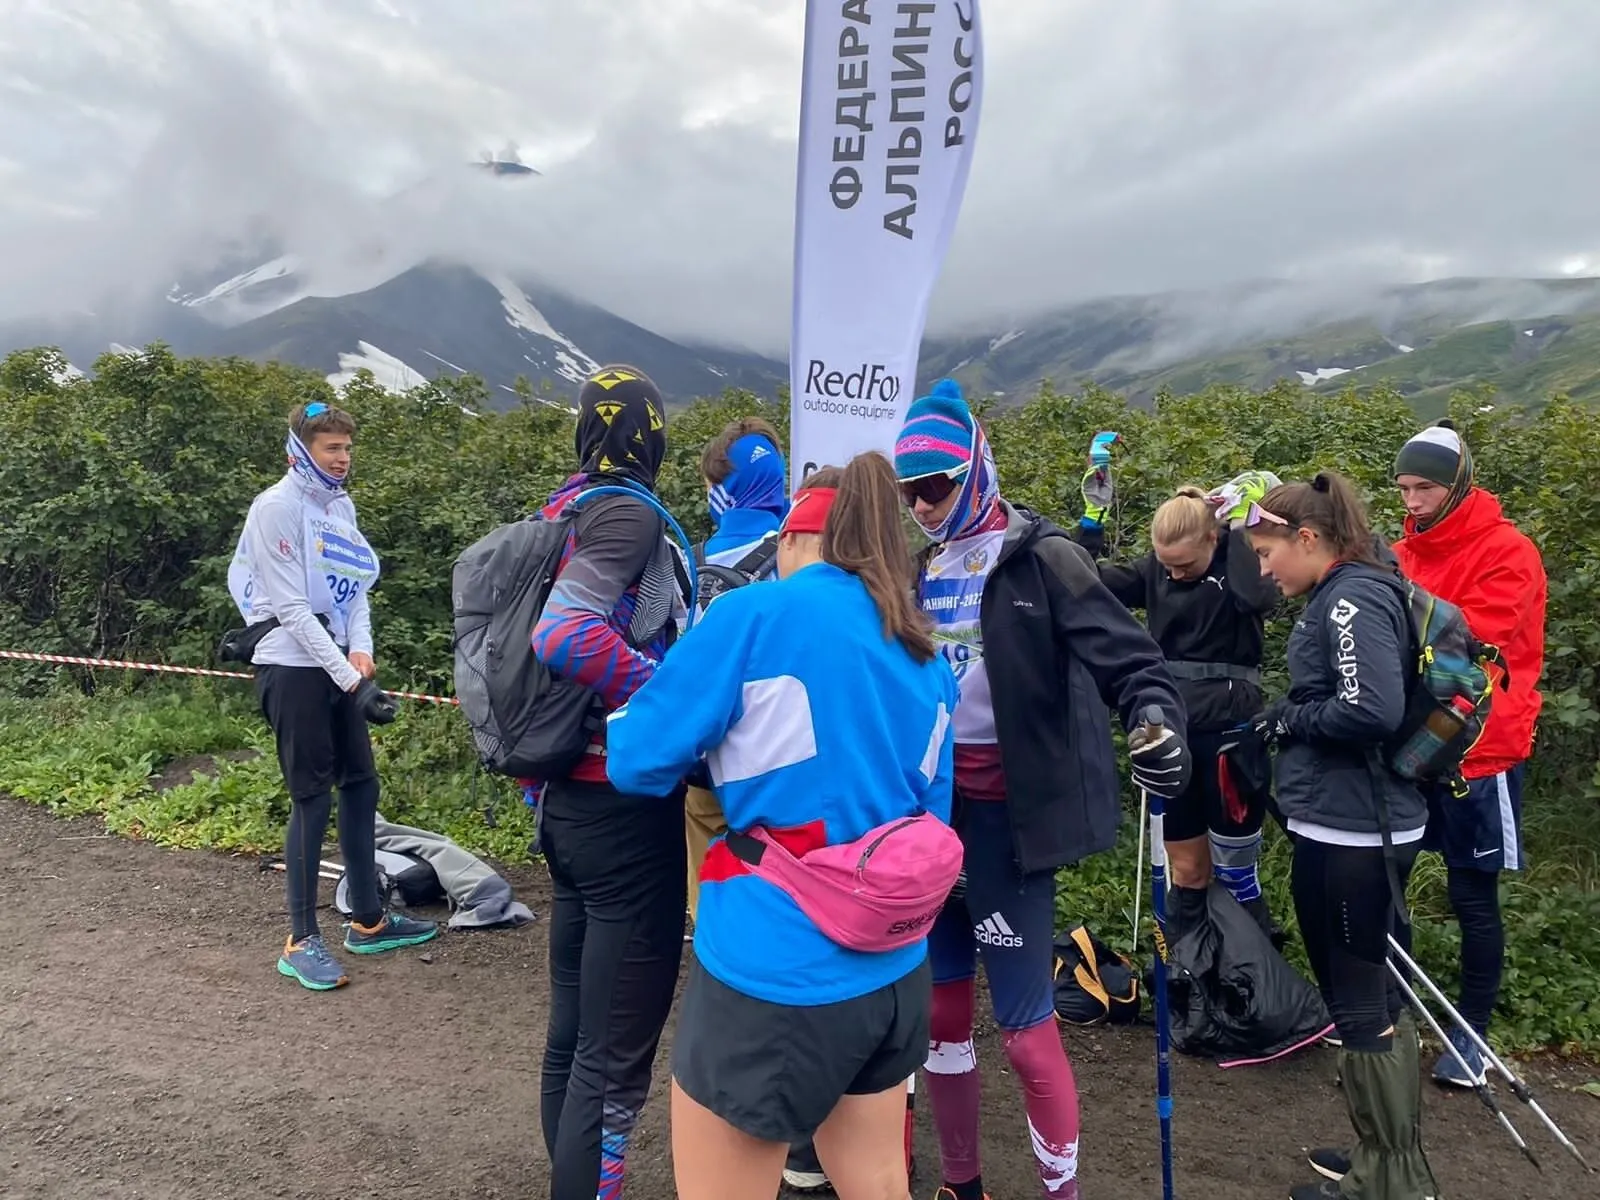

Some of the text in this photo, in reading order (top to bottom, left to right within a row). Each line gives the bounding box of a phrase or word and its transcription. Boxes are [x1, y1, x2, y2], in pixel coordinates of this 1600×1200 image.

[829, 0, 876, 209] ФЕДЕРА
[884, 3, 936, 240] АЛЬПИН
[803, 398, 848, 414] outdoor
[1337, 623, 1360, 705] RedFox
[974, 929, 1024, 948] adidas
